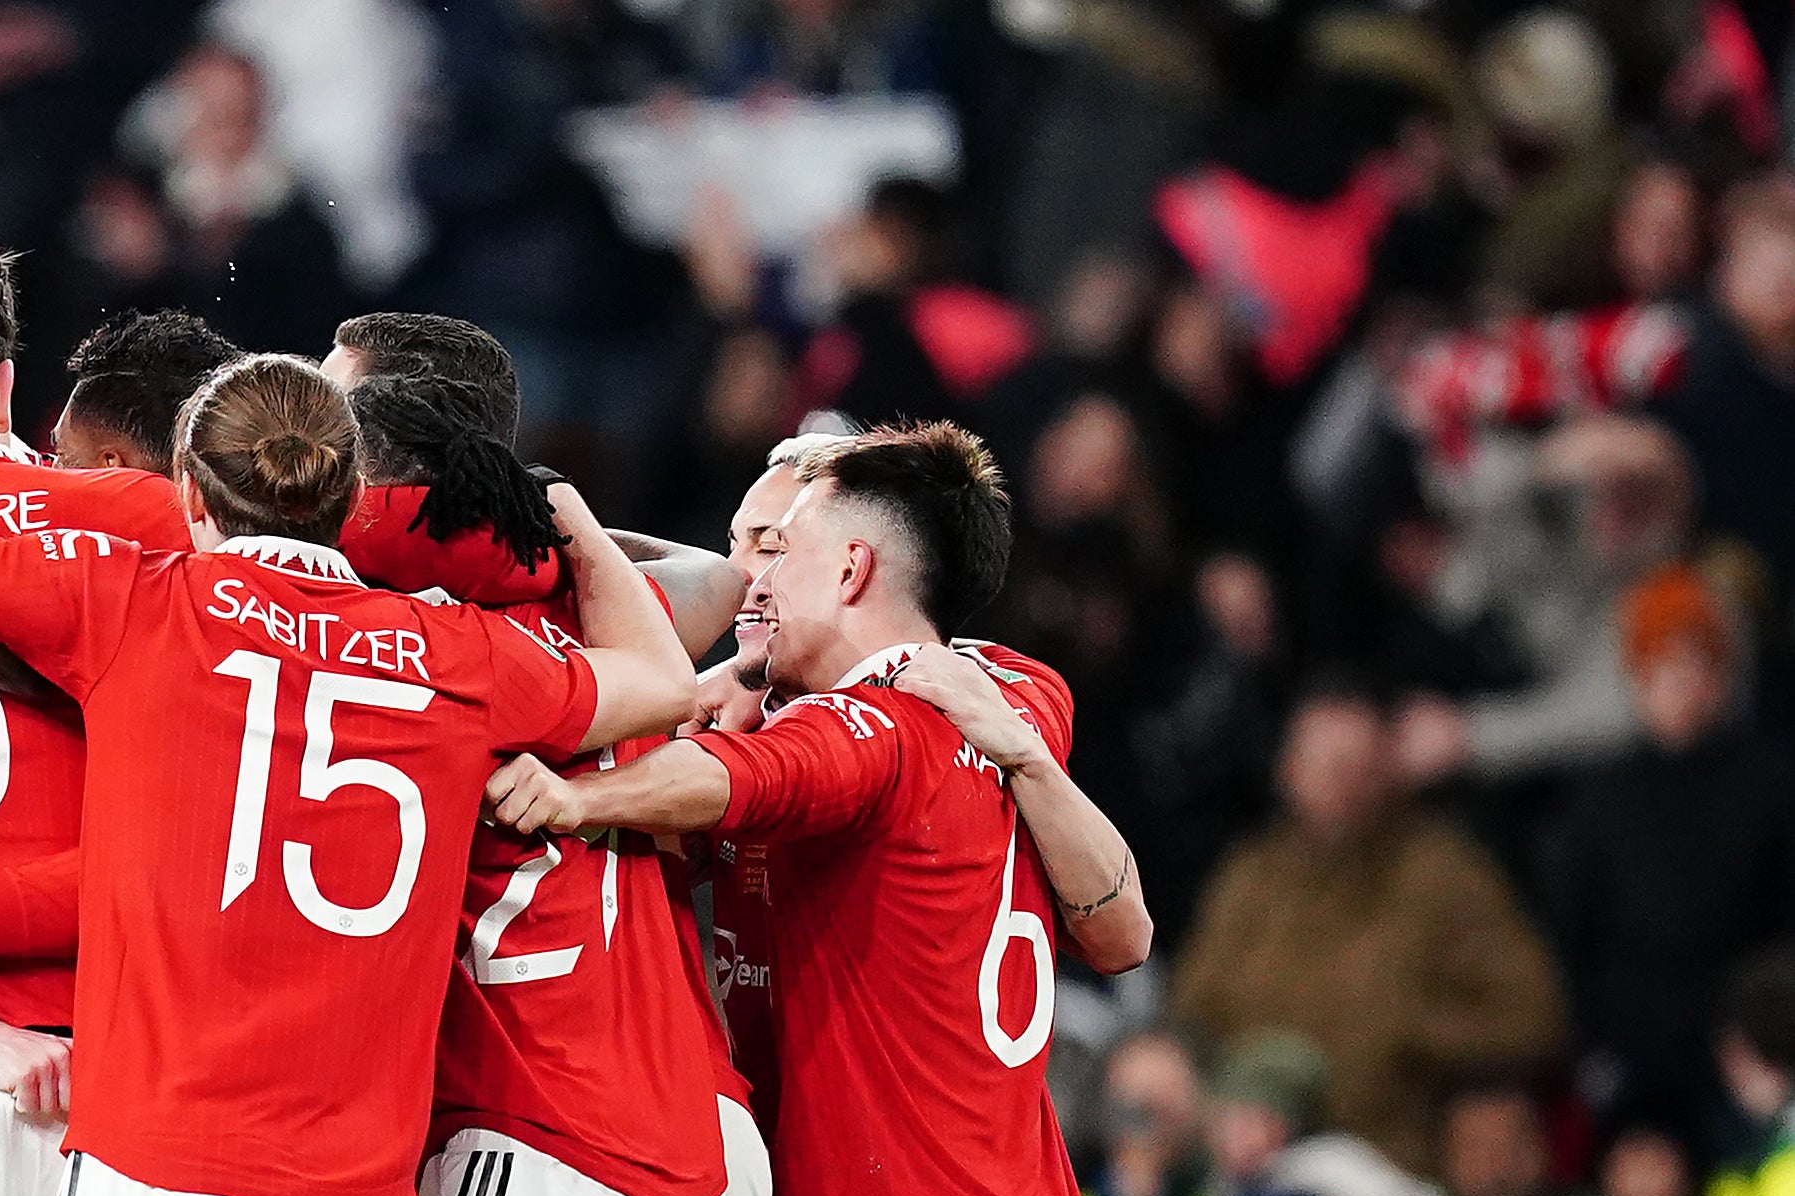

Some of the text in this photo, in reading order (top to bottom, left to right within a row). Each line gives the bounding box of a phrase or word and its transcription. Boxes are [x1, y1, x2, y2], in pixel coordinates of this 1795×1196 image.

[206, 578, 431, 682] SABITZER
[212, 649, 437, 937] 15
[978, 812, 1055, 1069] 6
